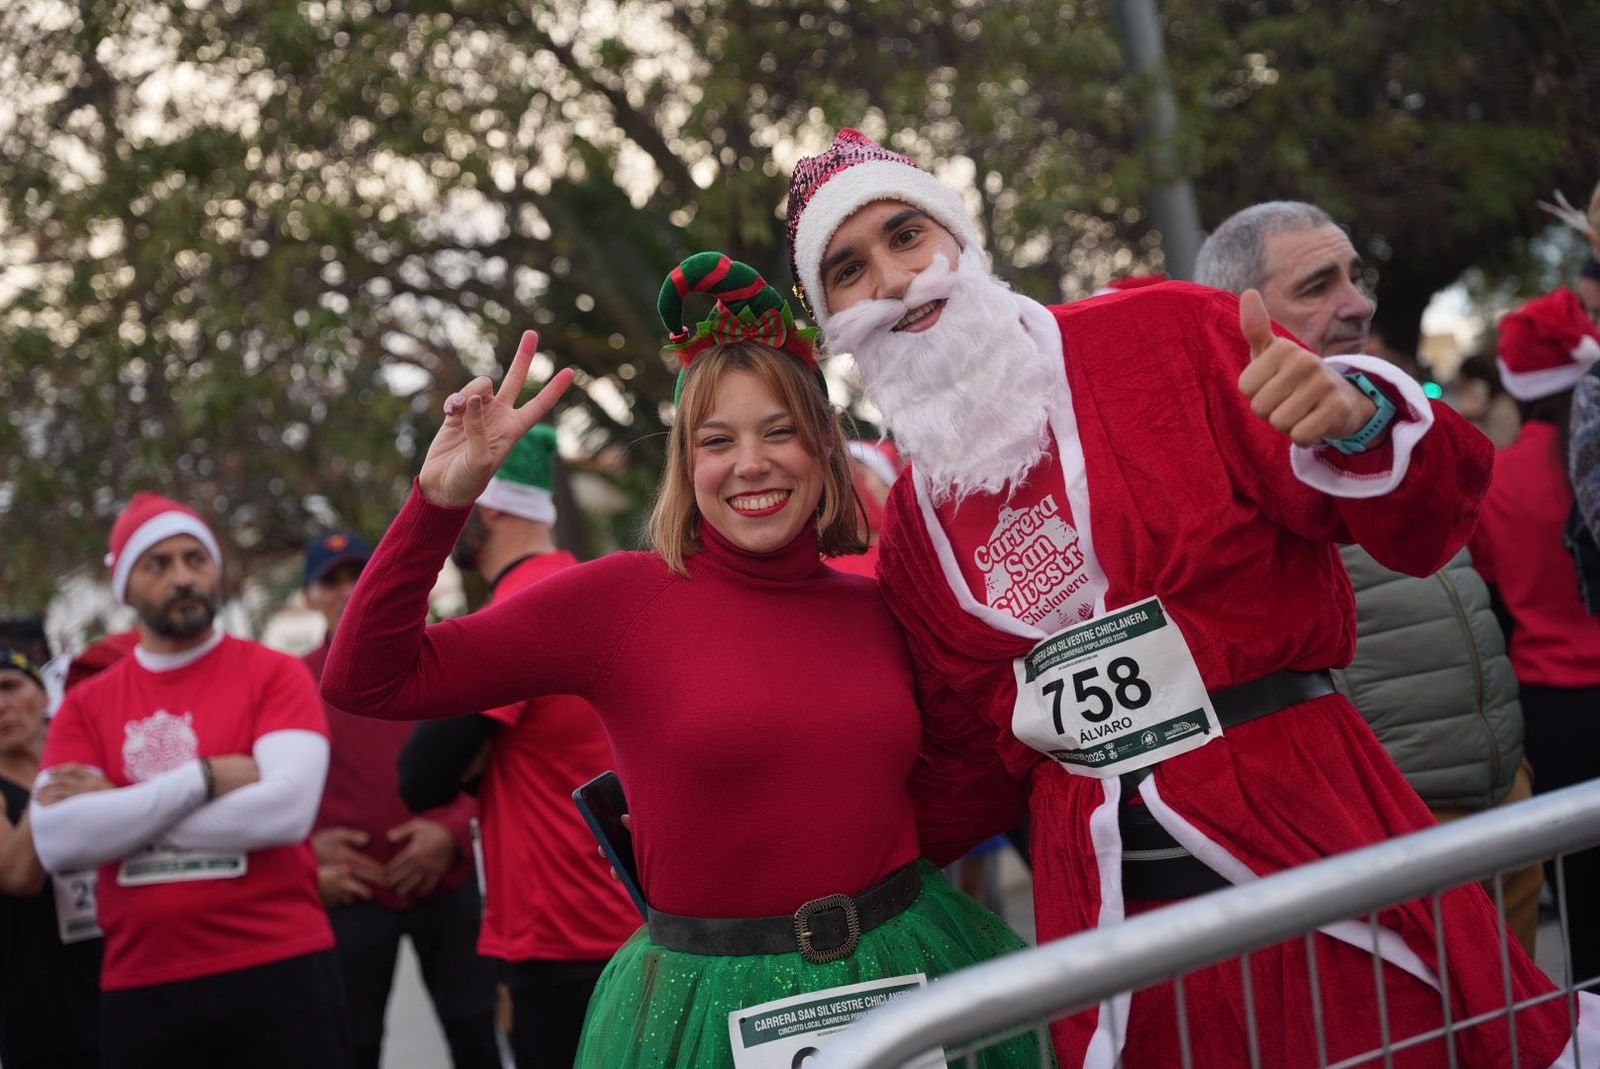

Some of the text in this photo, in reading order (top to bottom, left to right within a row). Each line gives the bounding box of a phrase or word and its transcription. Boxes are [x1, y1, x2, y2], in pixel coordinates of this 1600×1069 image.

[974, 494, 1059, 573] Carrera
[991, 540, 1084, 618] Silvestr
[1004, 535, 1057, 584] San
[1022, 573, 1089, 626] Chiclanera
[1046, 641, 1058, 657] SAN
[1057, 628, 1095, 652] SILVESTRE
[1095, 610, 1148, 637] CHICLANERA
[1061, 645, 1085, 661] CARRERAS
[1084, 635, 1113, 652] POPULARES
[1113, 631, 1128, 643] 2025
[1042, 656, 1152, 736] 758
[1080, 717, 1133, 744] ÁLVARO
[754, 1011, 797, 1032] CARRERA
[798, 1006, 816, 1021] SAN
[817, 997, 865, 1016] SILVESTRE
[778, 1023, 804, 1036] CIRCUITO
[804, 1019, 821, 1030] LOCAL
[822, 1013, 851, 1026] CARRERAS
